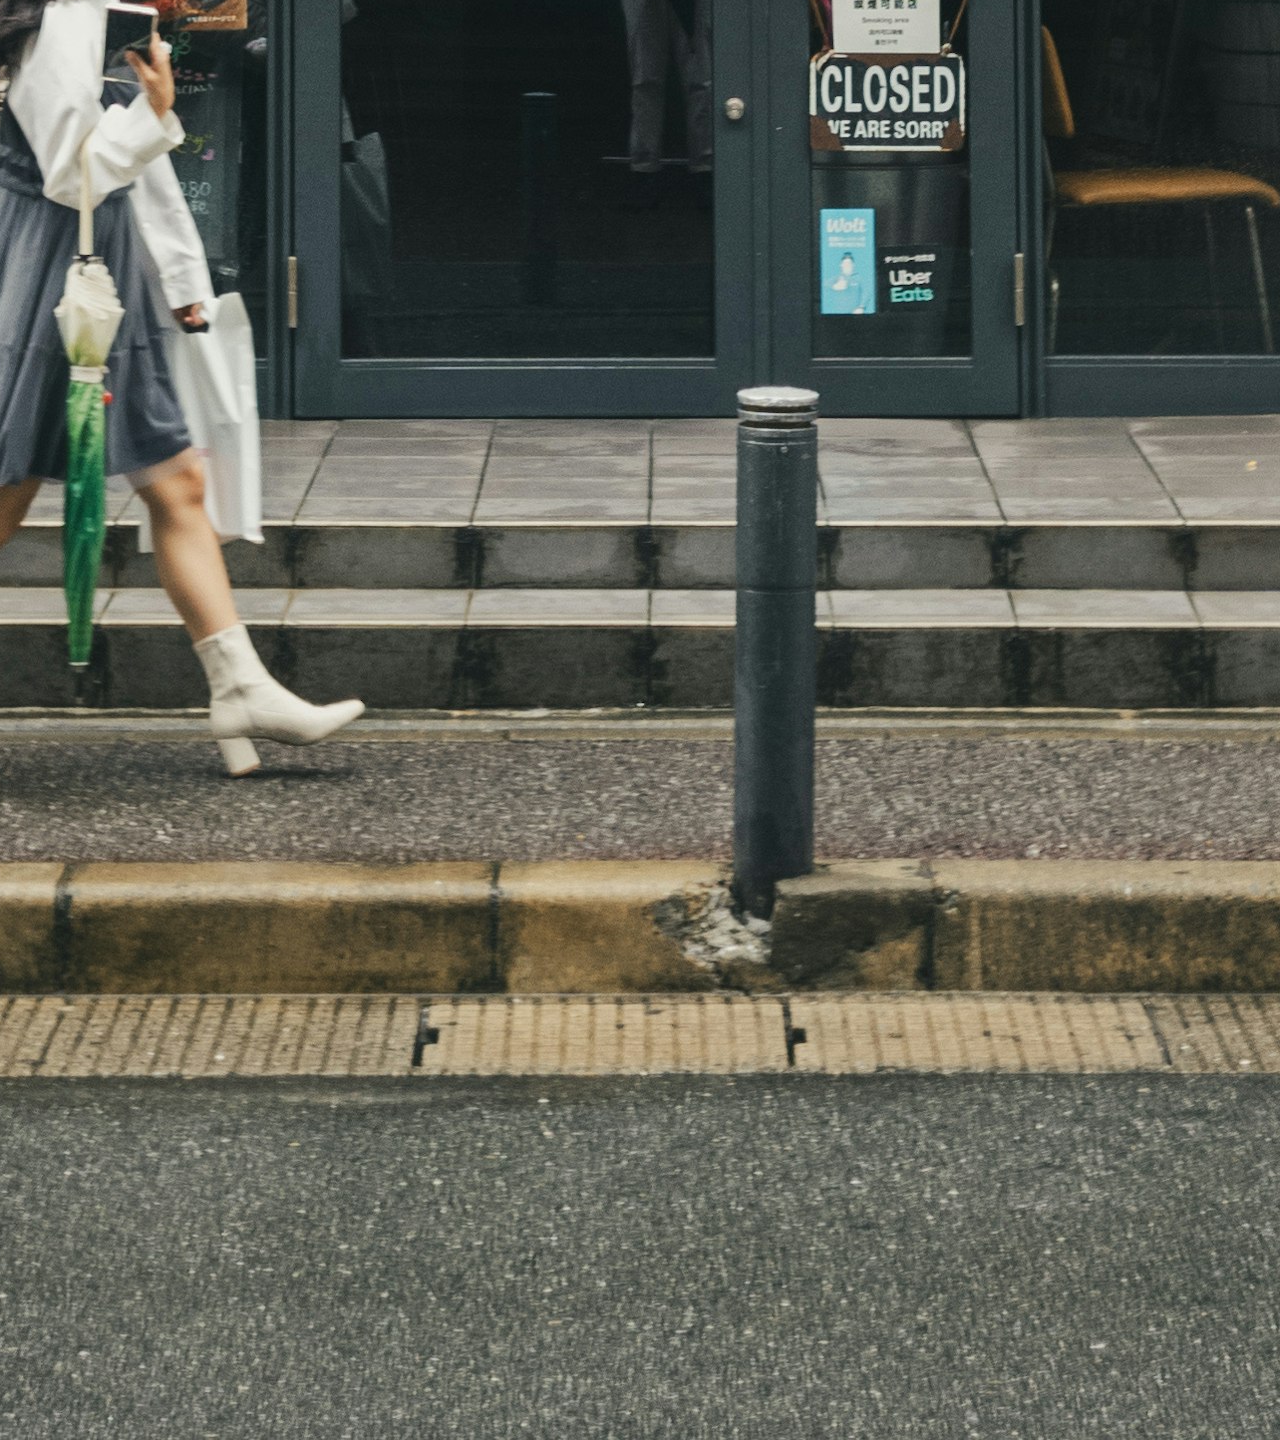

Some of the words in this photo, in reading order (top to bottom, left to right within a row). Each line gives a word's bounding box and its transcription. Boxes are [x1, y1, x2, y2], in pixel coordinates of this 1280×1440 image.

[820, 64, 956, 113] CLOSED
[854, 119, 892, 139] ARE
[893, 120, 950, 139] SORR
[826, 218, 866, 233] Wolt
[888, 269, 933, 286] Uber
[890, 287, 934, 303] Eats
